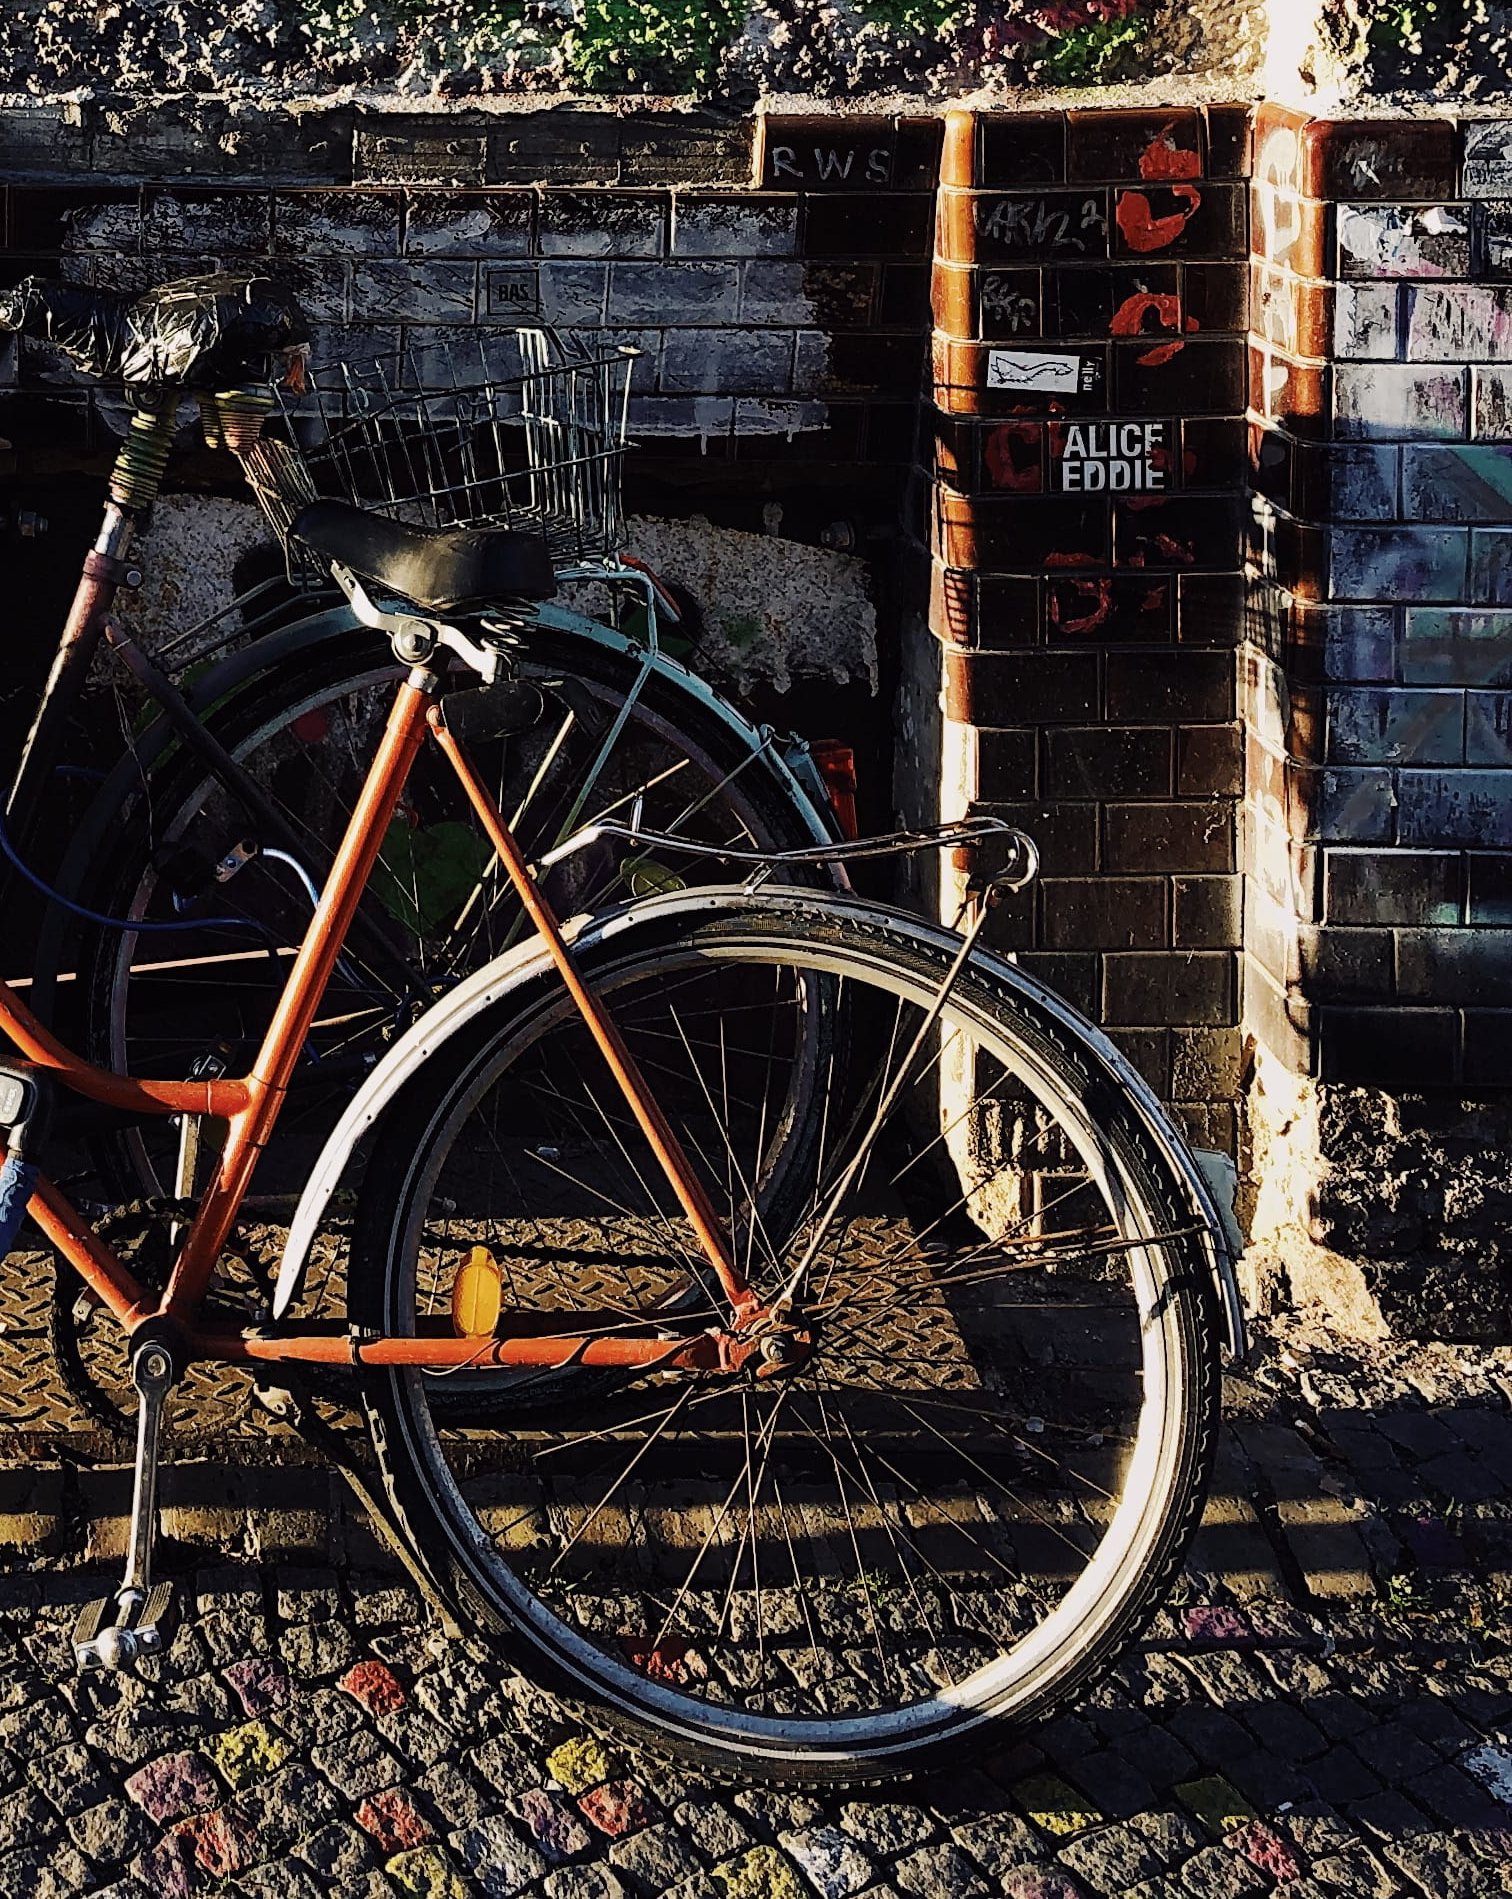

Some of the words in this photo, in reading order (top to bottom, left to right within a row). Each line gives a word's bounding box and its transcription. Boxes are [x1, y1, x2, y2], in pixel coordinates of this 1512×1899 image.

[771, 145, 889, 184] RWS
[1061, 422, 1165, 459] ALICE
[1061, 459, 1166, 492] EDDIE
